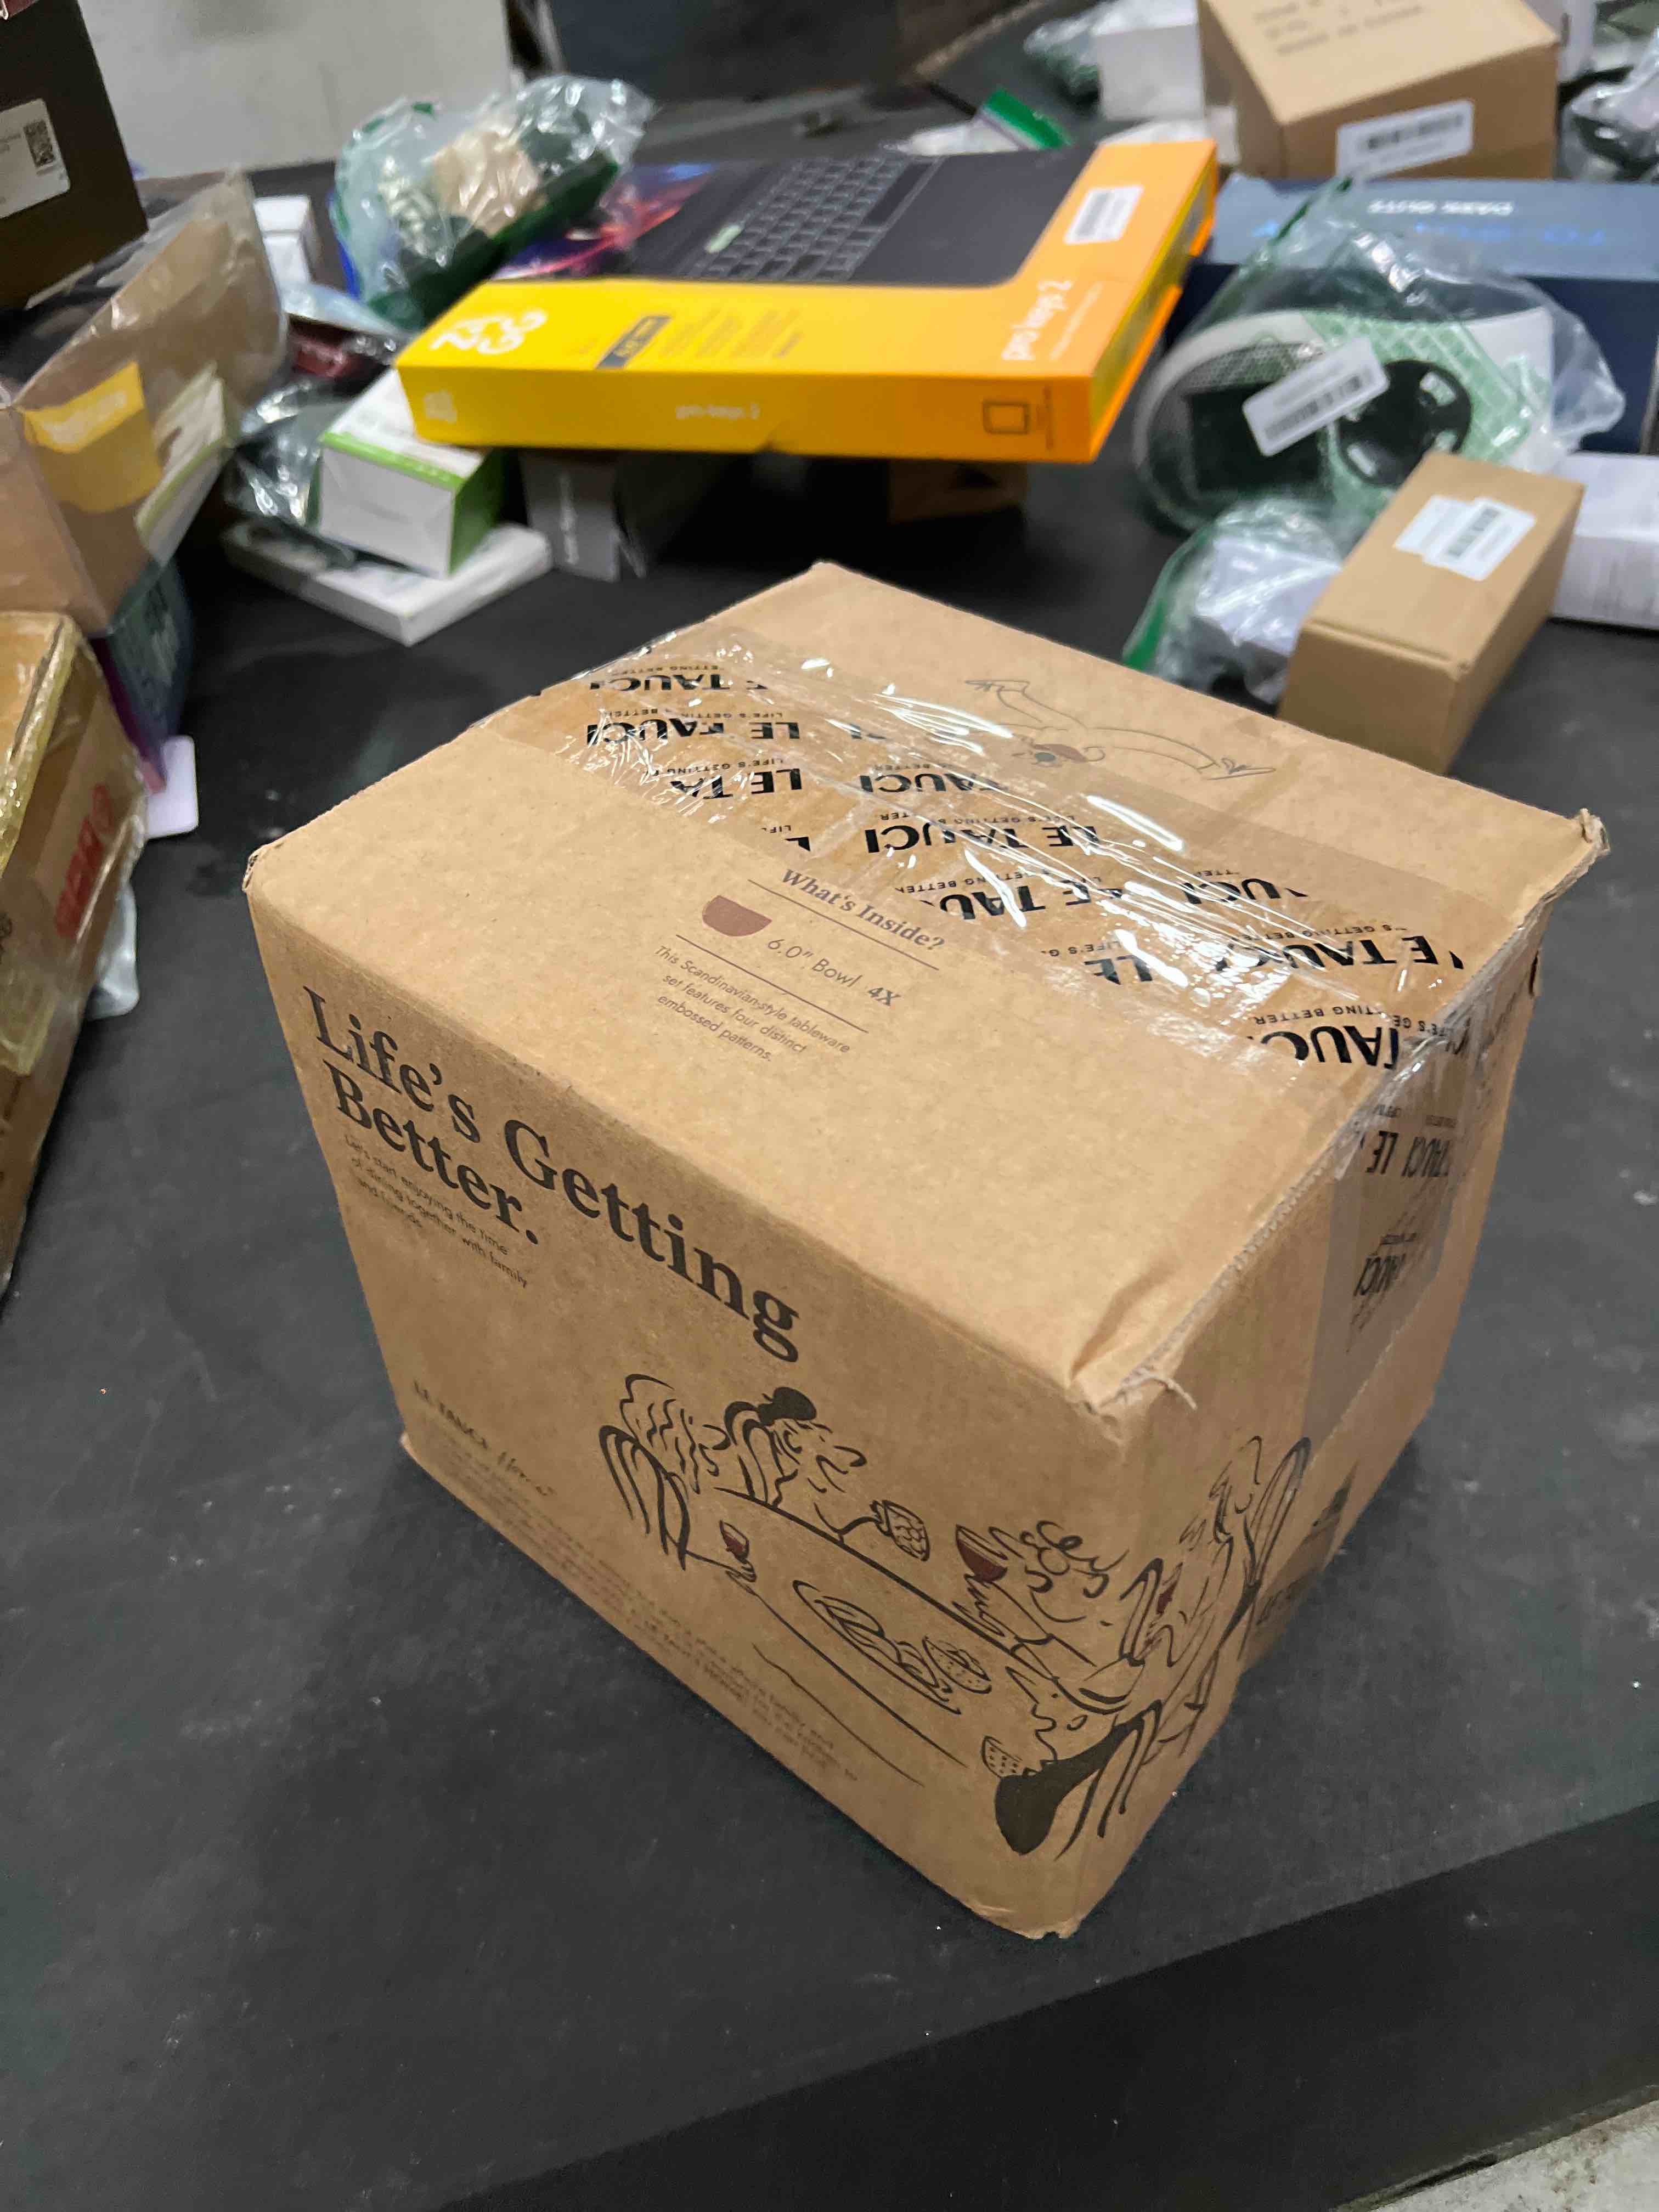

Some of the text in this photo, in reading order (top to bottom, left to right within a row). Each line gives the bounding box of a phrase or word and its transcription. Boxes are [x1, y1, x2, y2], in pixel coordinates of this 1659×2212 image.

[749, 722, 800, 740] LE
[751, 768, 803, 795] LE
[781, 868, 945, 951] What's Inside?
[654, 946, 850, 1053] This Scandinavian-style tableware
[767, 939, 901, 1007] 6.0" Bowl 4X
[658, 995, 772, 1062] embossed patterns.
[663, 974, 808, 1053] set features four distinct
[303, 986, 800, 1364] Life's Getting
[323, 1059, 539, 1246] Better.
